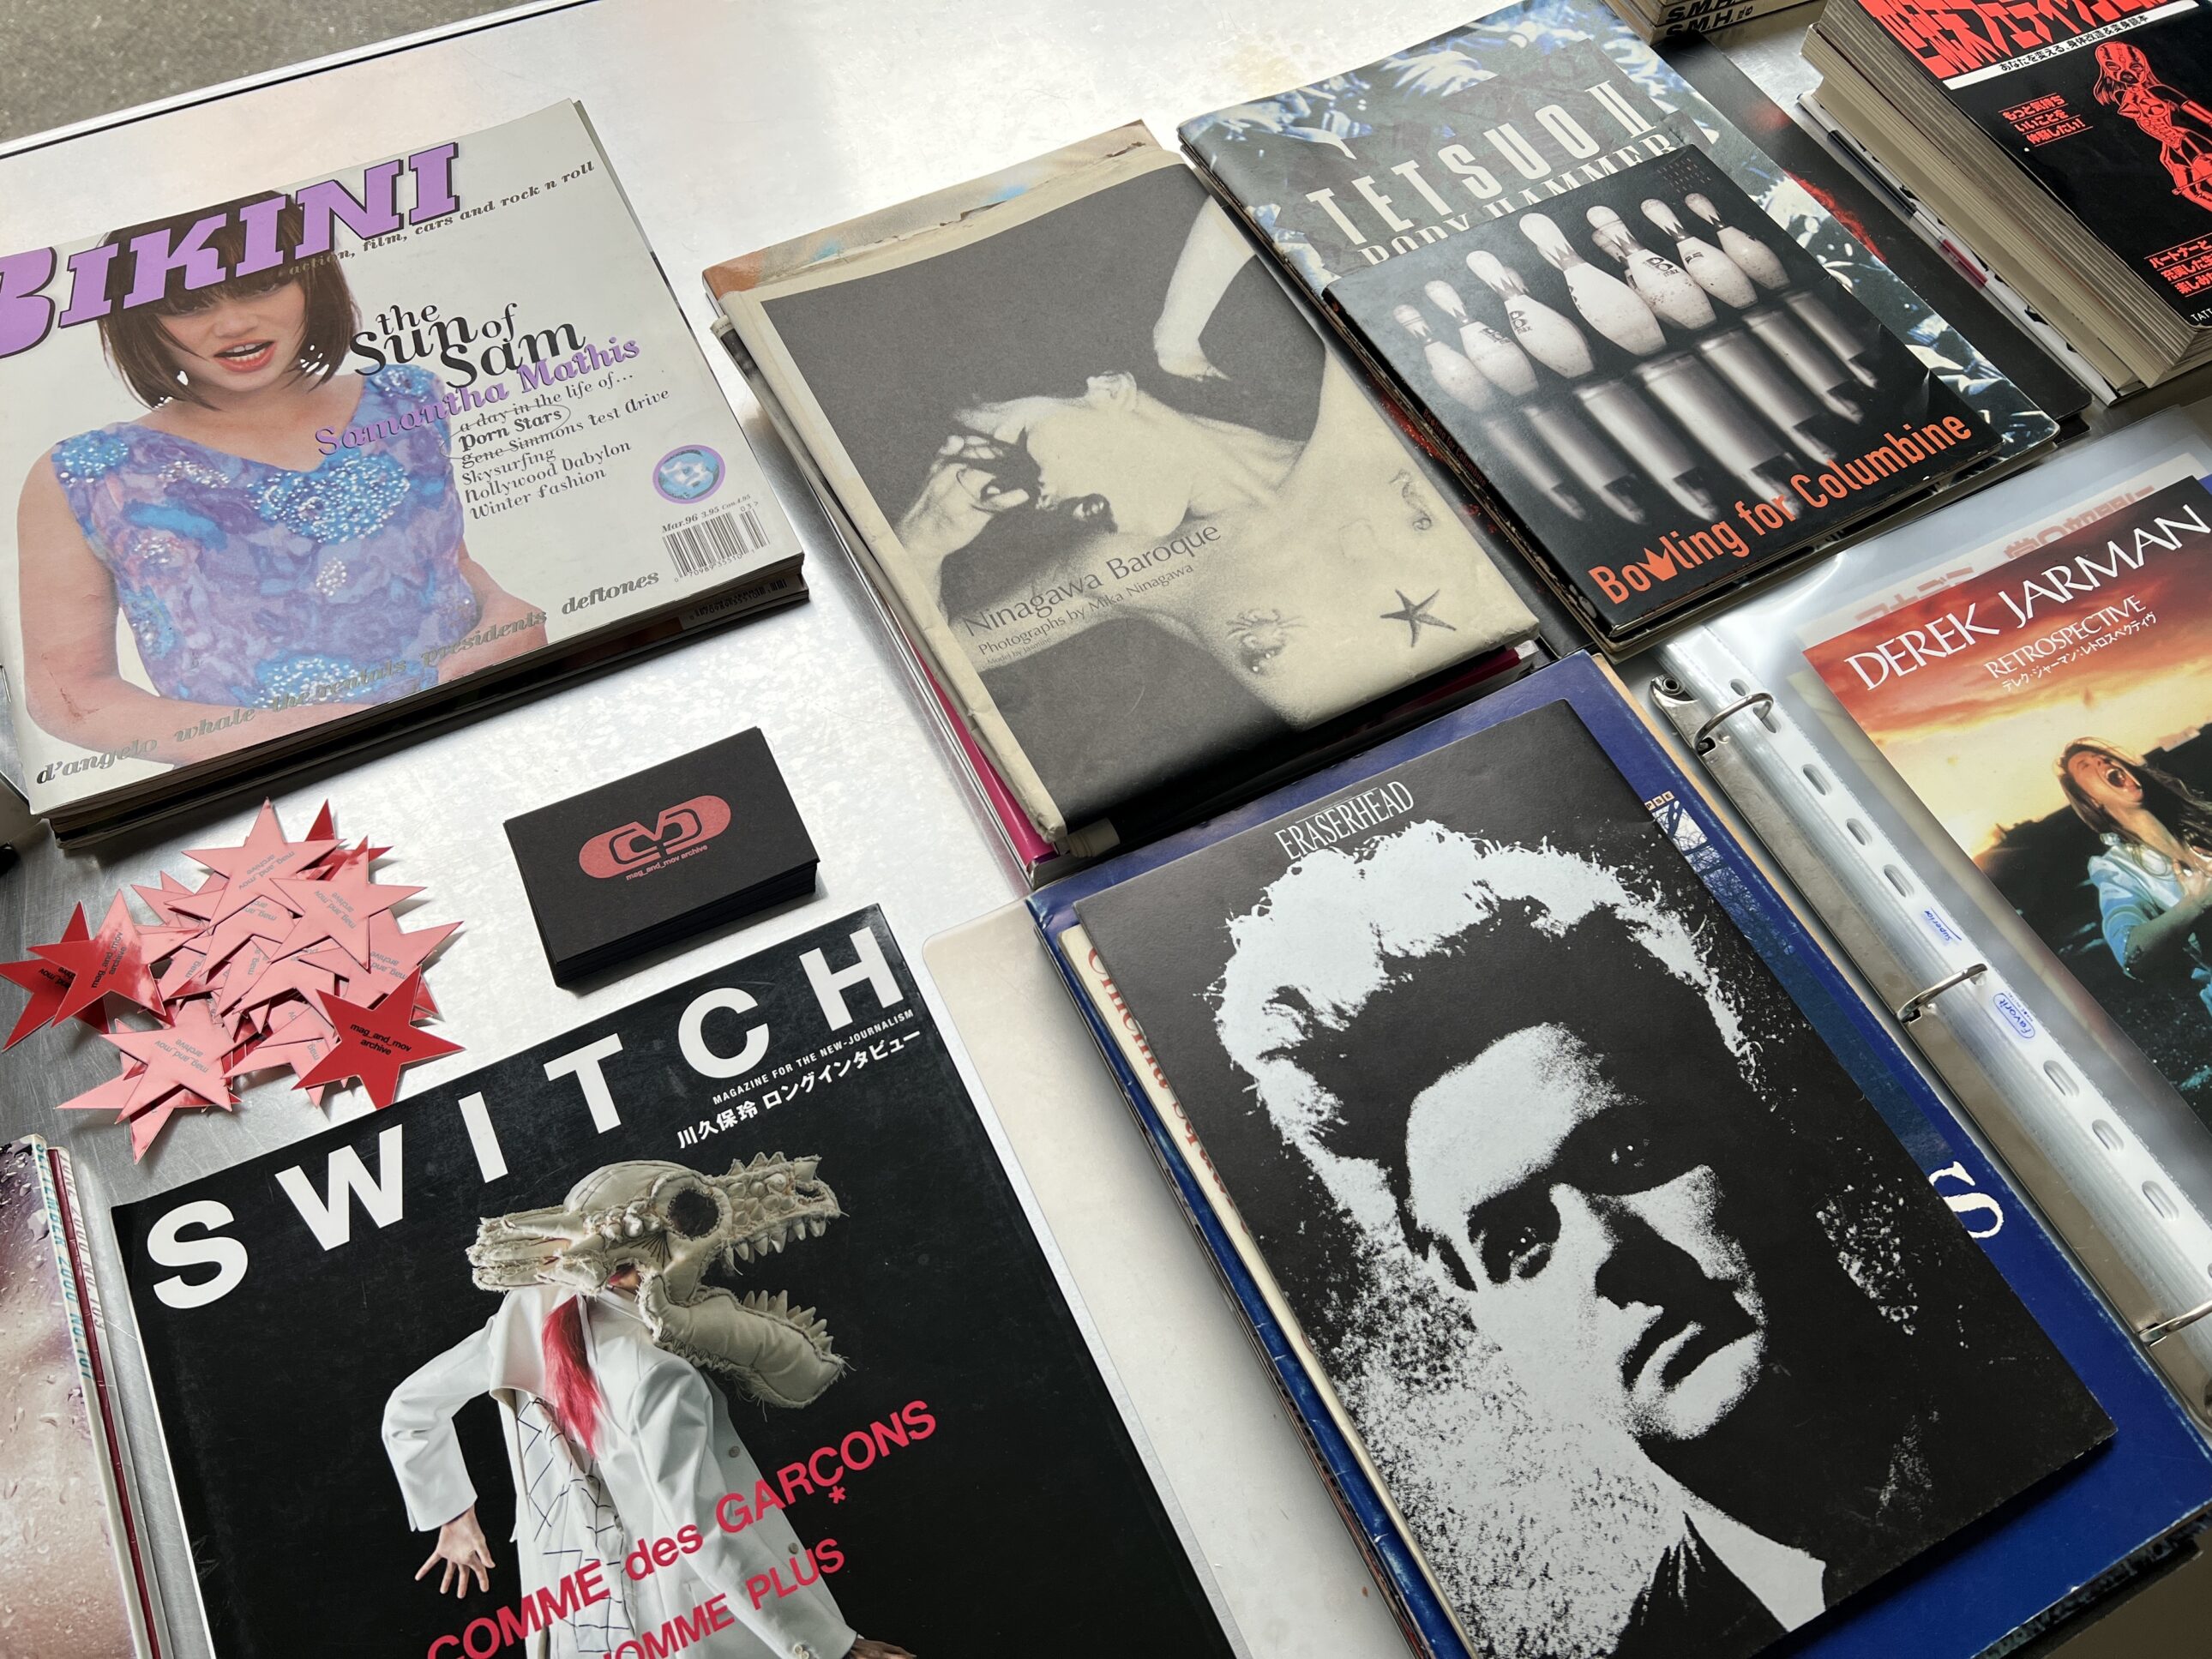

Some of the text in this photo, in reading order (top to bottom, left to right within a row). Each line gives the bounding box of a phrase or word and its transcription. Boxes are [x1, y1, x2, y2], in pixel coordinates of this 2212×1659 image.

[363, 232, 408, 253] film,
[415, 213, 454, 236] cars
[460, 201, 496, 220] and
[500, 185, 540, 207] rock
[544, 179, 557, 191] n
[561, 161, 594, 183] roll
[1306, 104, 1600, 245] TETSUO
[0, 141, 460, 358] BIKINI
[376, 304, 441, 335] the
[482, 303, 518, 341] of
[440, 322, 586, 390] Sam
[315, 337, 640, 454] Samantha Mathis
[460, 422, 471, 433] a
[477, 410, 508, 428] day
[513, 403, 532, 416] in
[534, 394, 562, 409] the
[565, 381, 593, 400] life
[514, 410, 562, 432] Stars
[461, 448, 557, 486] Skysurfing
[508, 422, 584, 453] Simmons
[470, 492, 532, 520] Winter
[1734, 494, 1798, 537] for
[1789, 415, 1972, 509] Columbine
[962, 526, 1222, 637] Ninagawa Baroque
[978, 563, 1195, 656] Photographs by Mika Ninagawa
[1843, 602, 1999, 691] DEREK
[1998, 504, 2211, 628] JARMAN
[173, 708, 255, 742] whale
[562, 571, 660, 616] deftones
[1984, 595, 2147, 679] RETROSPECTIVE
[1274, 781, 1414, 861] ERASERHEAD
[625, 844, 708, 881] mag_and_mov archive
[109, 947, 127, 976] archive
[175, 1038, 204, 1057] archive
[351, 1024, 412, 1052] mag_and_mov
[360, 1039, 392, 1055] archive
[1998, 997, 2033, 1035] Favorit
[154, 1040, 208, 1073] mag_and_mov
[676, 1031, 922, 1149] 川久保玲 ロングインタビュー
[712, 1009, 914, 1105] MAGAZINE FOR THE NEW-JOURNALISM
[147, 926, 904, 1309] SWITCH
[428, 1560, 612, 1659] COMME
[624, 1523, 705, 1583] des
[745, 1538, 846, 1610] PLUS
